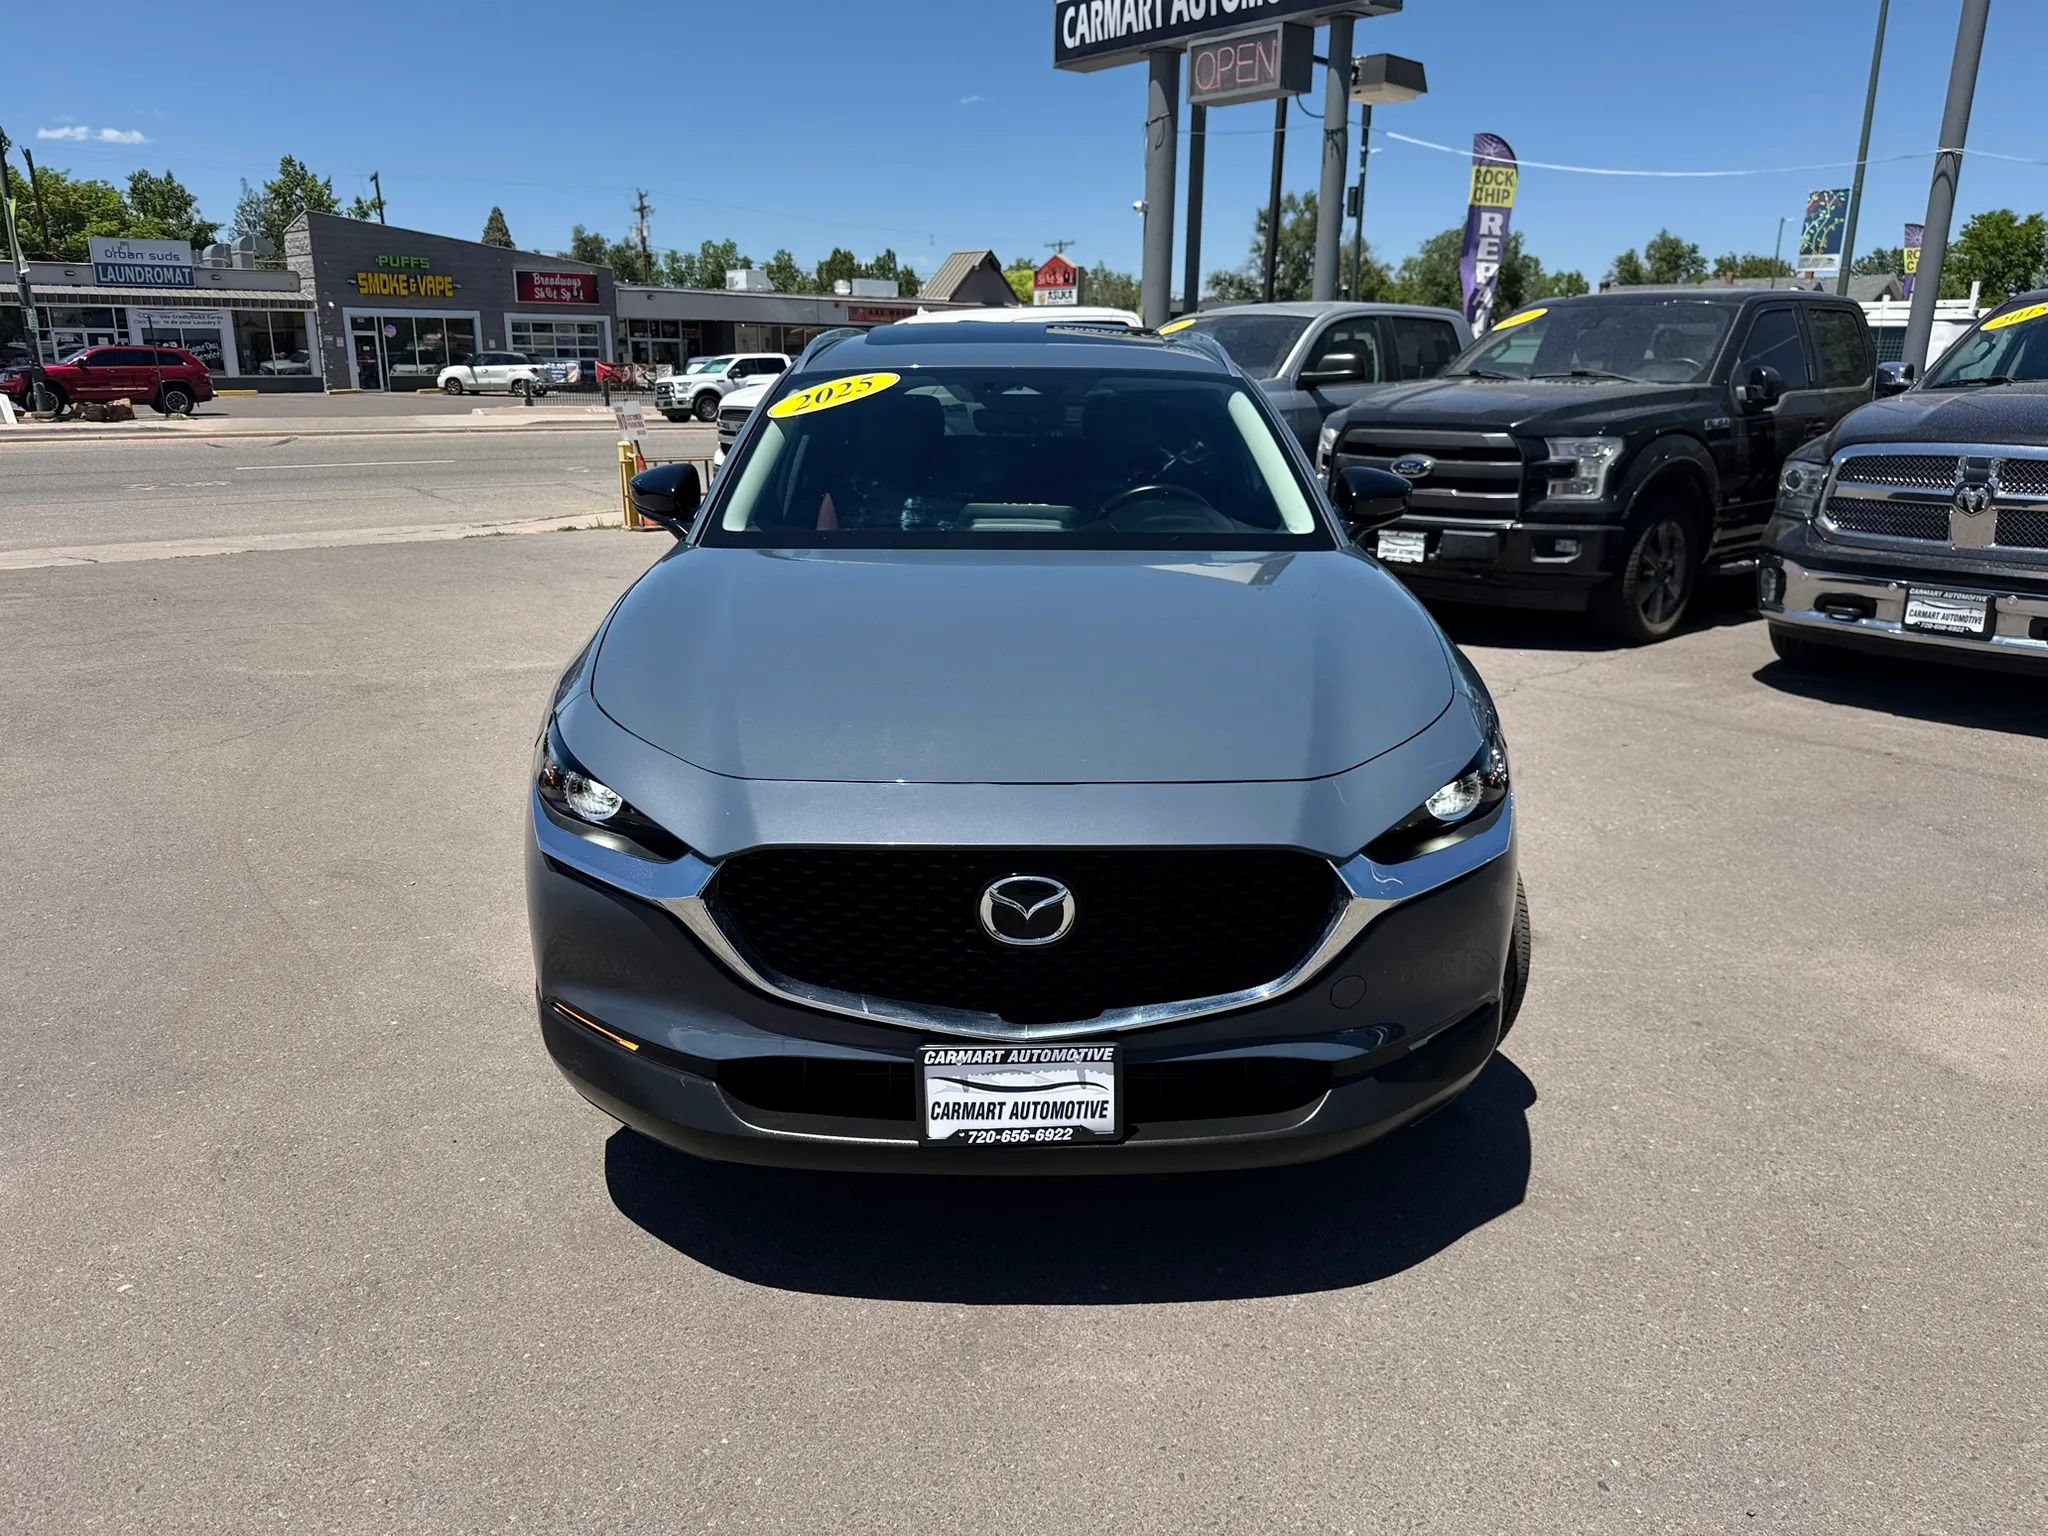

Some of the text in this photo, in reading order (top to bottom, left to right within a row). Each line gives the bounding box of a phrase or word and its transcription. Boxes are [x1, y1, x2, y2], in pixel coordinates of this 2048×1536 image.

[1063, 0, 1164, 49] CARMART
[1195, 38, 1277, 90] OPEN
[1474, 168, 1515, 188] ROCK
[1473, 186, 1511, 202] CHIP
[149, 251, 180, 262] suds
[378, 255, 430, 269] PUFFS
[98, 265, 191, 285] LAUNDROMAT
[357, 272, 409, 296] SMOKE
[417, 275, 454, 297] VAPE
[794, 375, 875, 412] 2025
[1908, 608, 1984, 625] CARMART AUTOMOTIVE
[924, 1048, 1114, 1065] CARMART AUTOMOTIVE
[930, 1100, 1110, 1121] CARMART AUTOMOTIVE
[967, 1128, 1074, 1144] 720-656-6922
